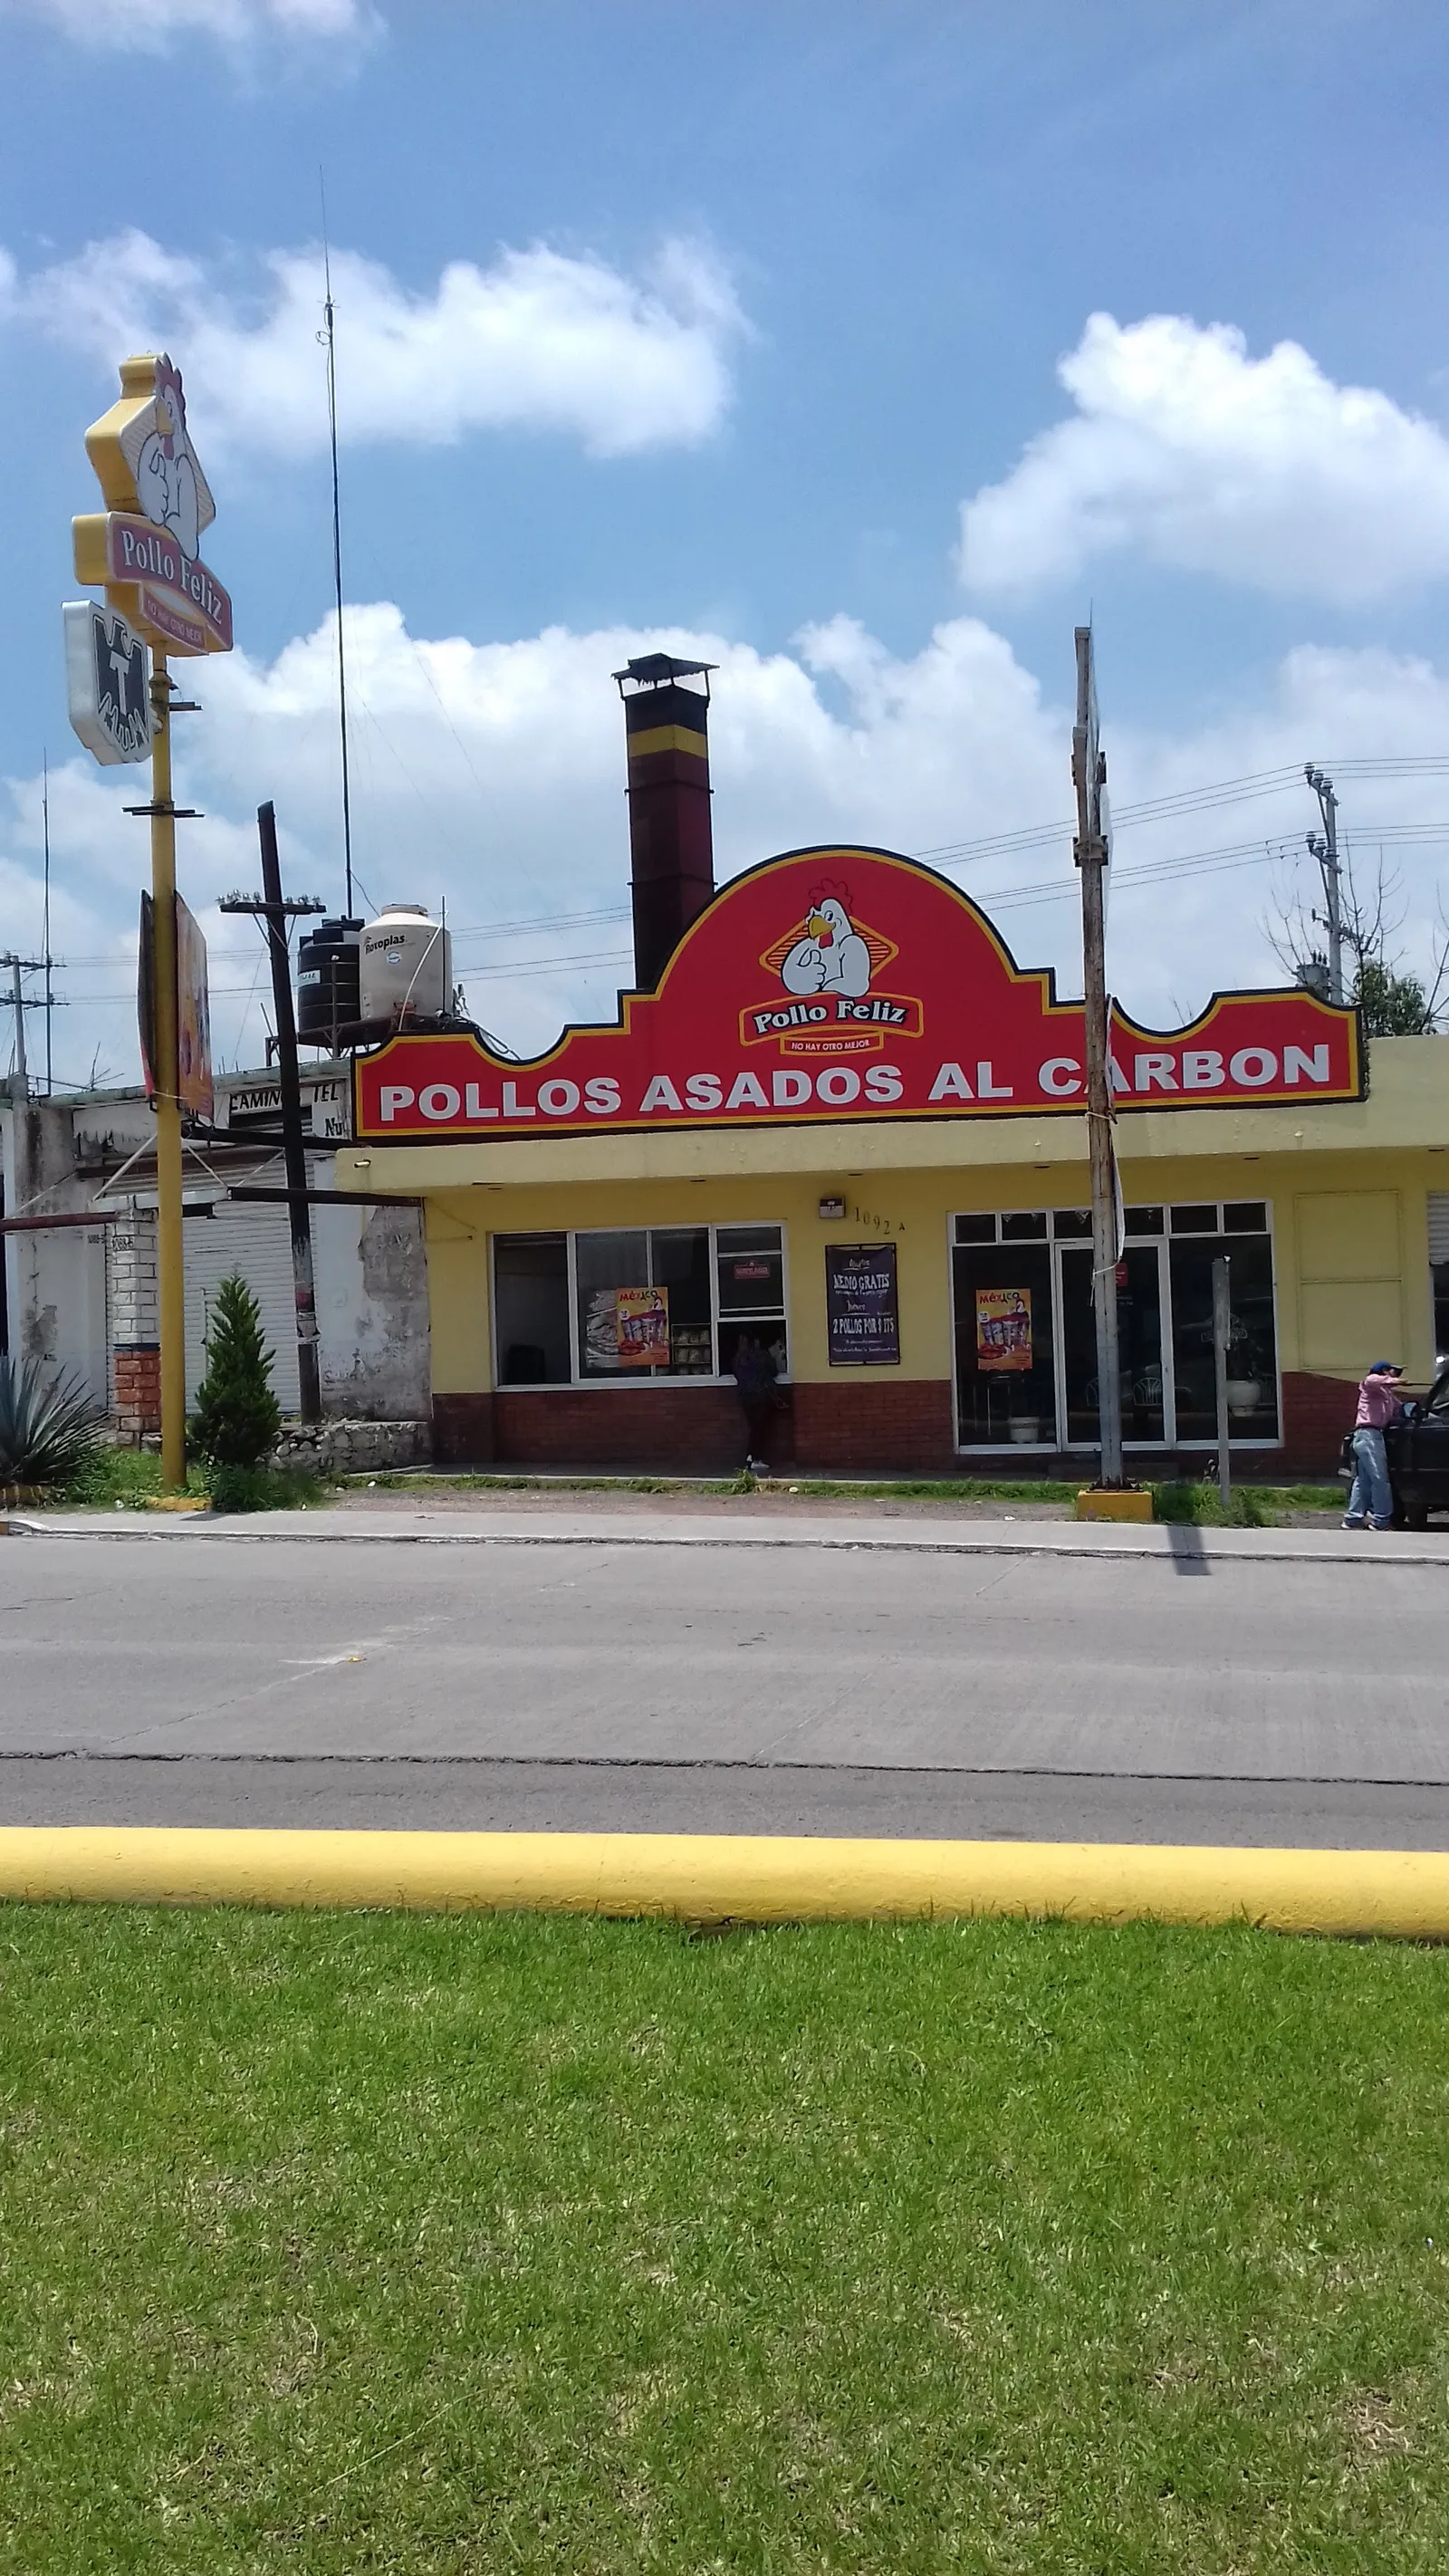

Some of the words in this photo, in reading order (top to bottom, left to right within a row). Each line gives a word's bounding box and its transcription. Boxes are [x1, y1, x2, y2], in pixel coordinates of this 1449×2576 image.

[121, 530, 174, 581] Pollo
[180, 554, 222, 625] Feliz
[753, 1004, 828, 1033] Pollo
[837, 1000, 907, 1024] Feliz
[791, 1042, 803, 1051] NO
[805, 1043, 820, 1051] HAY
[822, 1042, 843, 1051] OTRO
[844, 1039, 870, 1049] MEJOR
[379, 1077, 621, 1122] POLLOS
[638, 1064, 904, 1112] ASADOS
[927, 1061, 1014, 1101] AL
